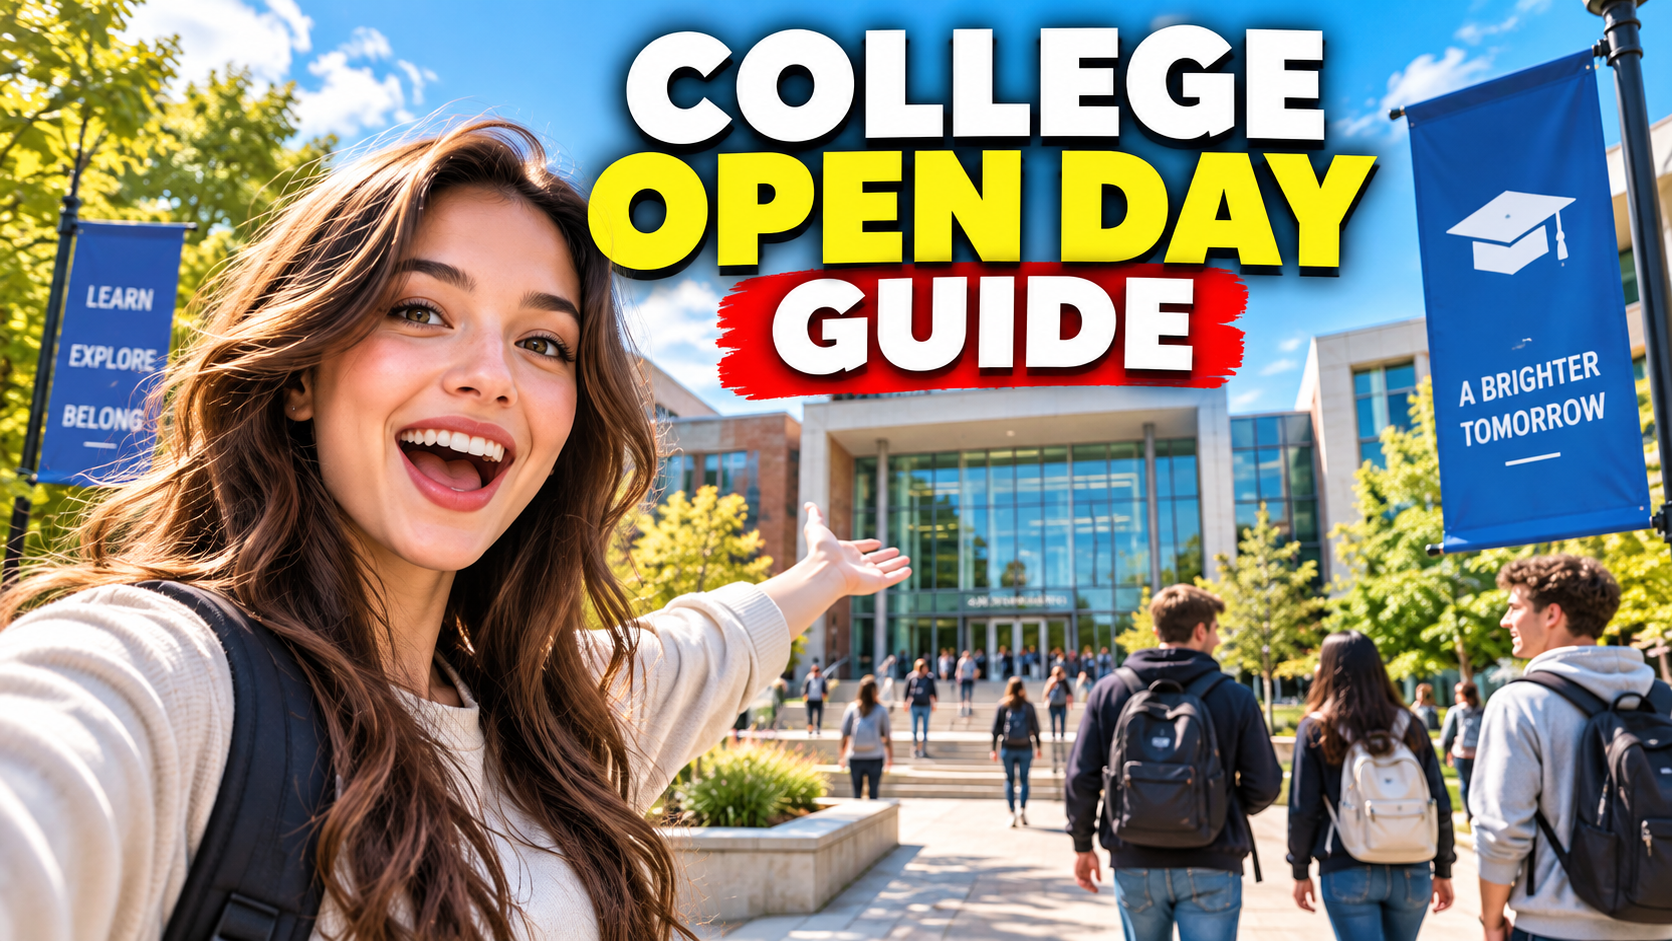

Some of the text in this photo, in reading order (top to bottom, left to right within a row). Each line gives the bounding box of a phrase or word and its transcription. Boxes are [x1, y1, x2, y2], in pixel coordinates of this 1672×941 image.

[86, 284, 154, 312] LEARN
[69, 343, 158, 373] EXPLORE
[1459, 350, 1602, 408] A BRIGHTER
[62, 403, 143, 433] BELONG
[1460, 391, 1606, 447] TOMORROW
